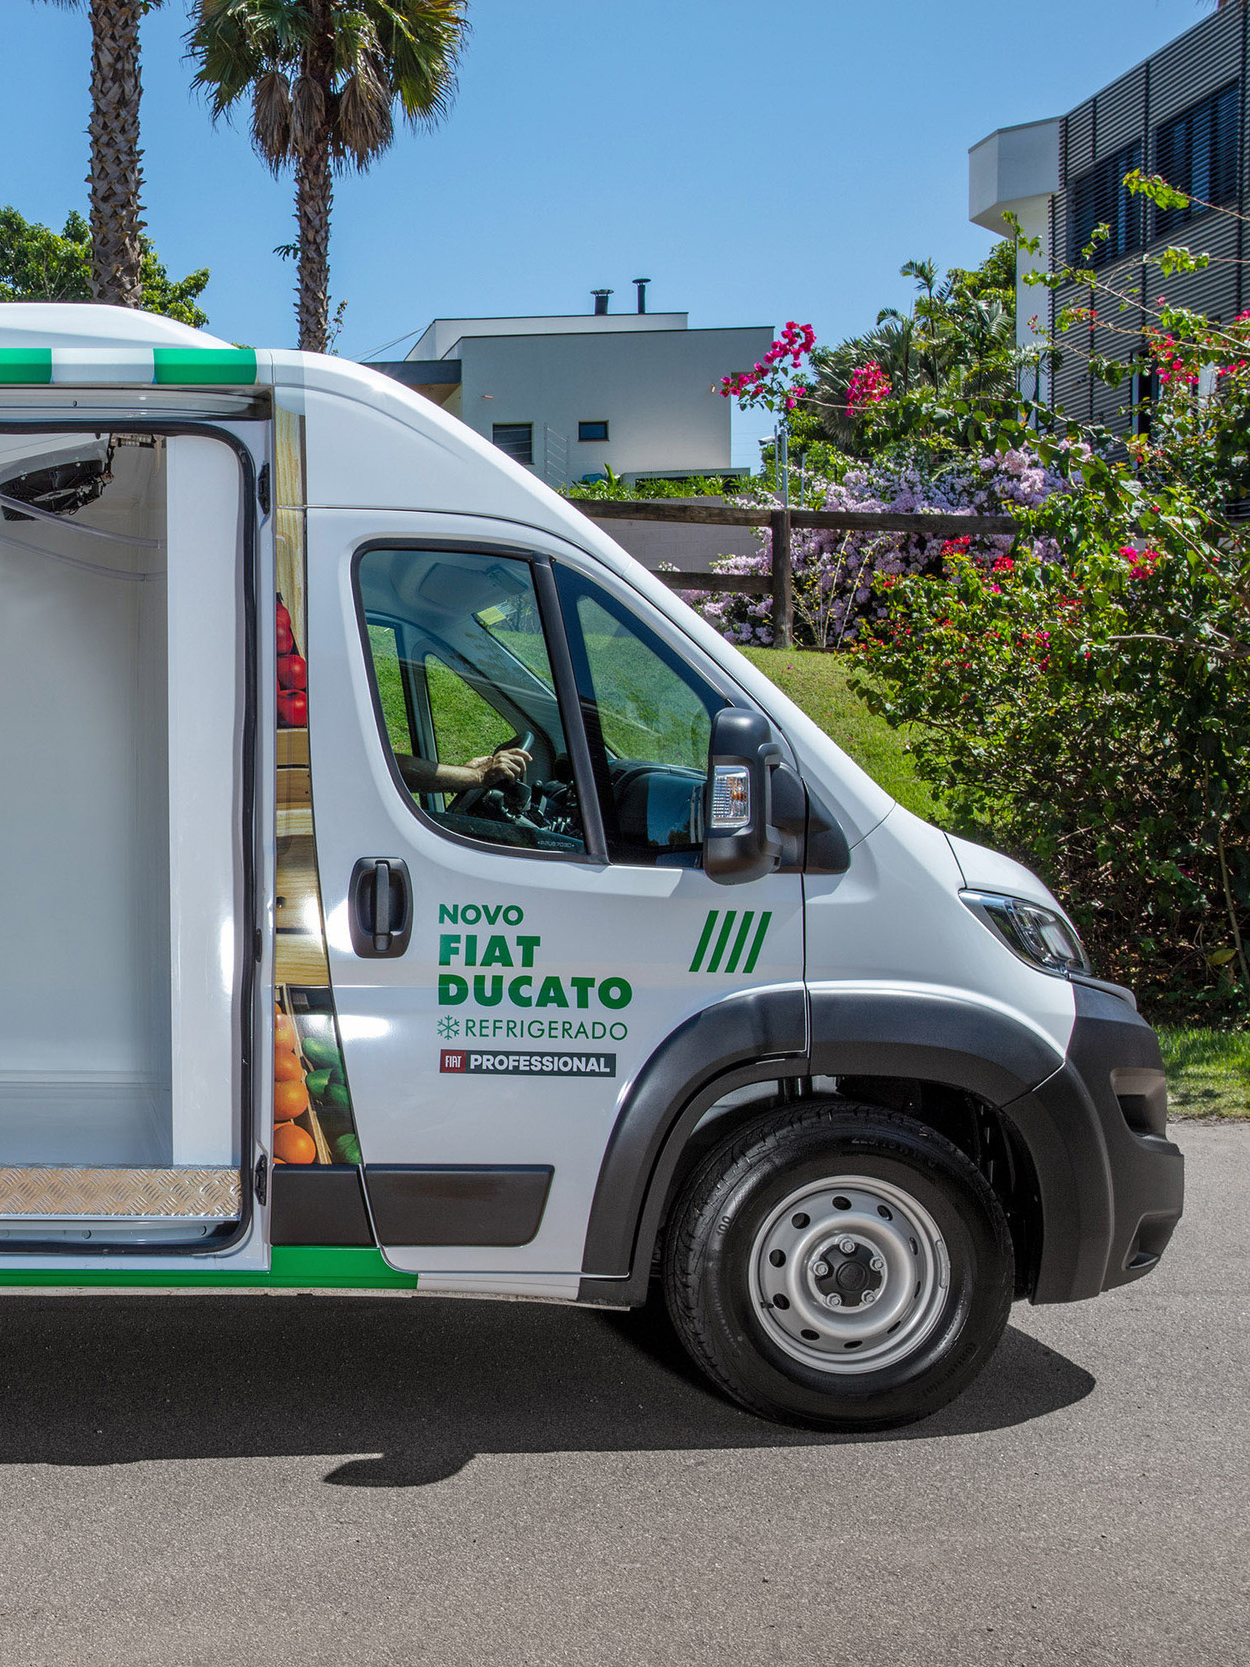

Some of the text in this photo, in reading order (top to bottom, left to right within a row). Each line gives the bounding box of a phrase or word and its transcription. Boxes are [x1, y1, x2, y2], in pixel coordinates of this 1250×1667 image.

[438, 903, 524, 926] NOVO
[438, 934, 541, 967] FIAT
[437, 973, 633, 1010] DUCATO
[465, 1018, 629, 1041] REFRIGERADO
[444, 1054, 611, 1073] FIAT PROFESSIONAL
